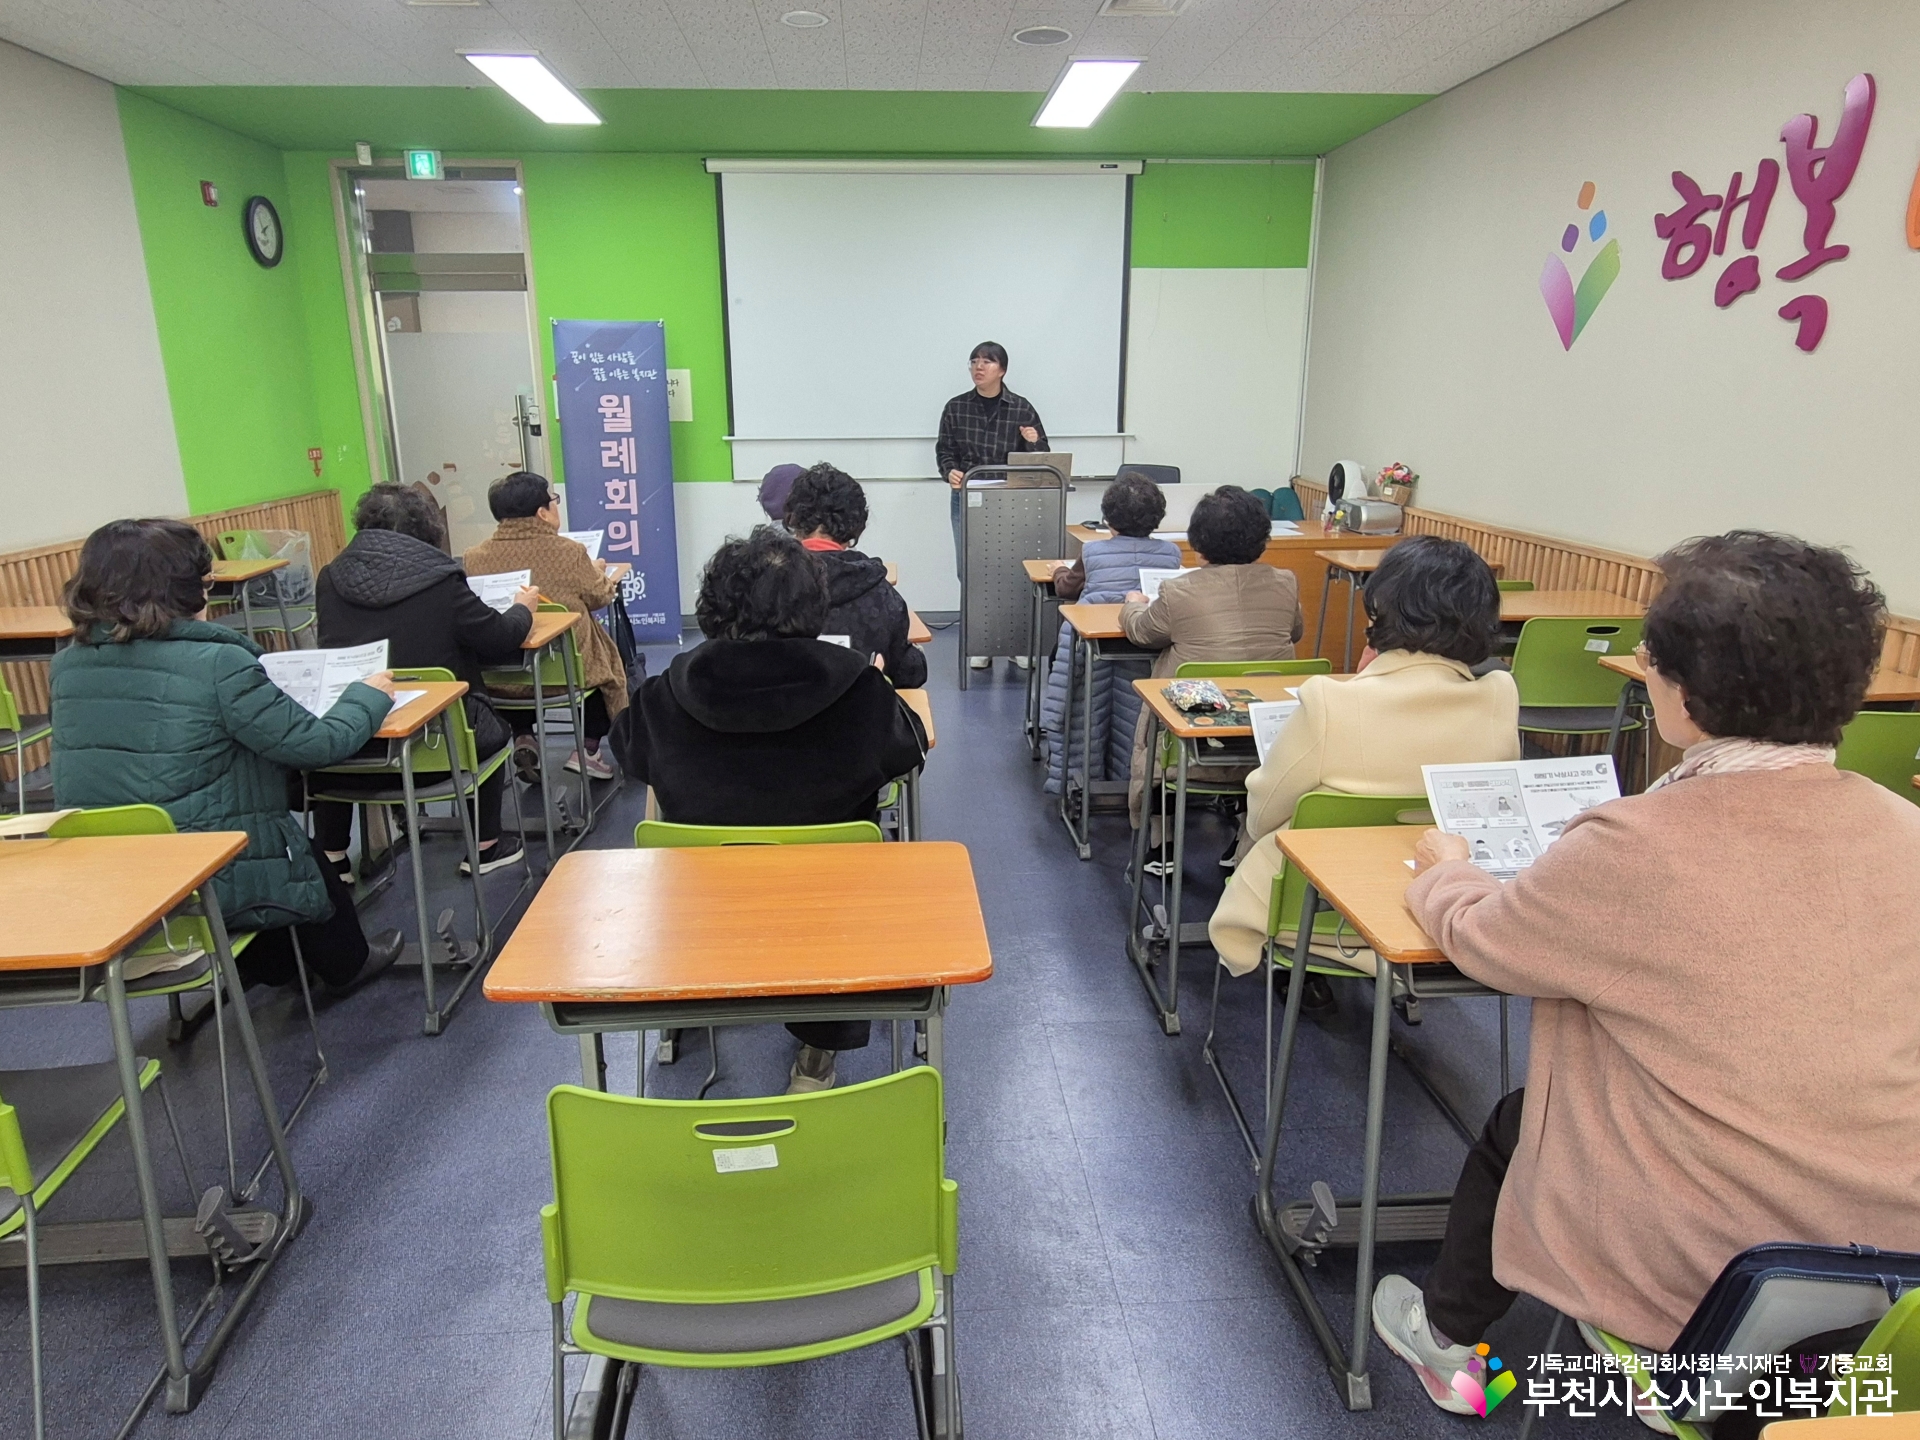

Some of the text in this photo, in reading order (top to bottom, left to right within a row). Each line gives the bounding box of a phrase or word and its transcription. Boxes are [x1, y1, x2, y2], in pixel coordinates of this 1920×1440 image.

[1654, 72, 1877, 353] 행복
[570, 350, 636, 365] 꿈이 있는 사람들
[592, 367, 658, 381] 꿈을 이루는 복지관
[597, 394, 640, 556] 월례회의
